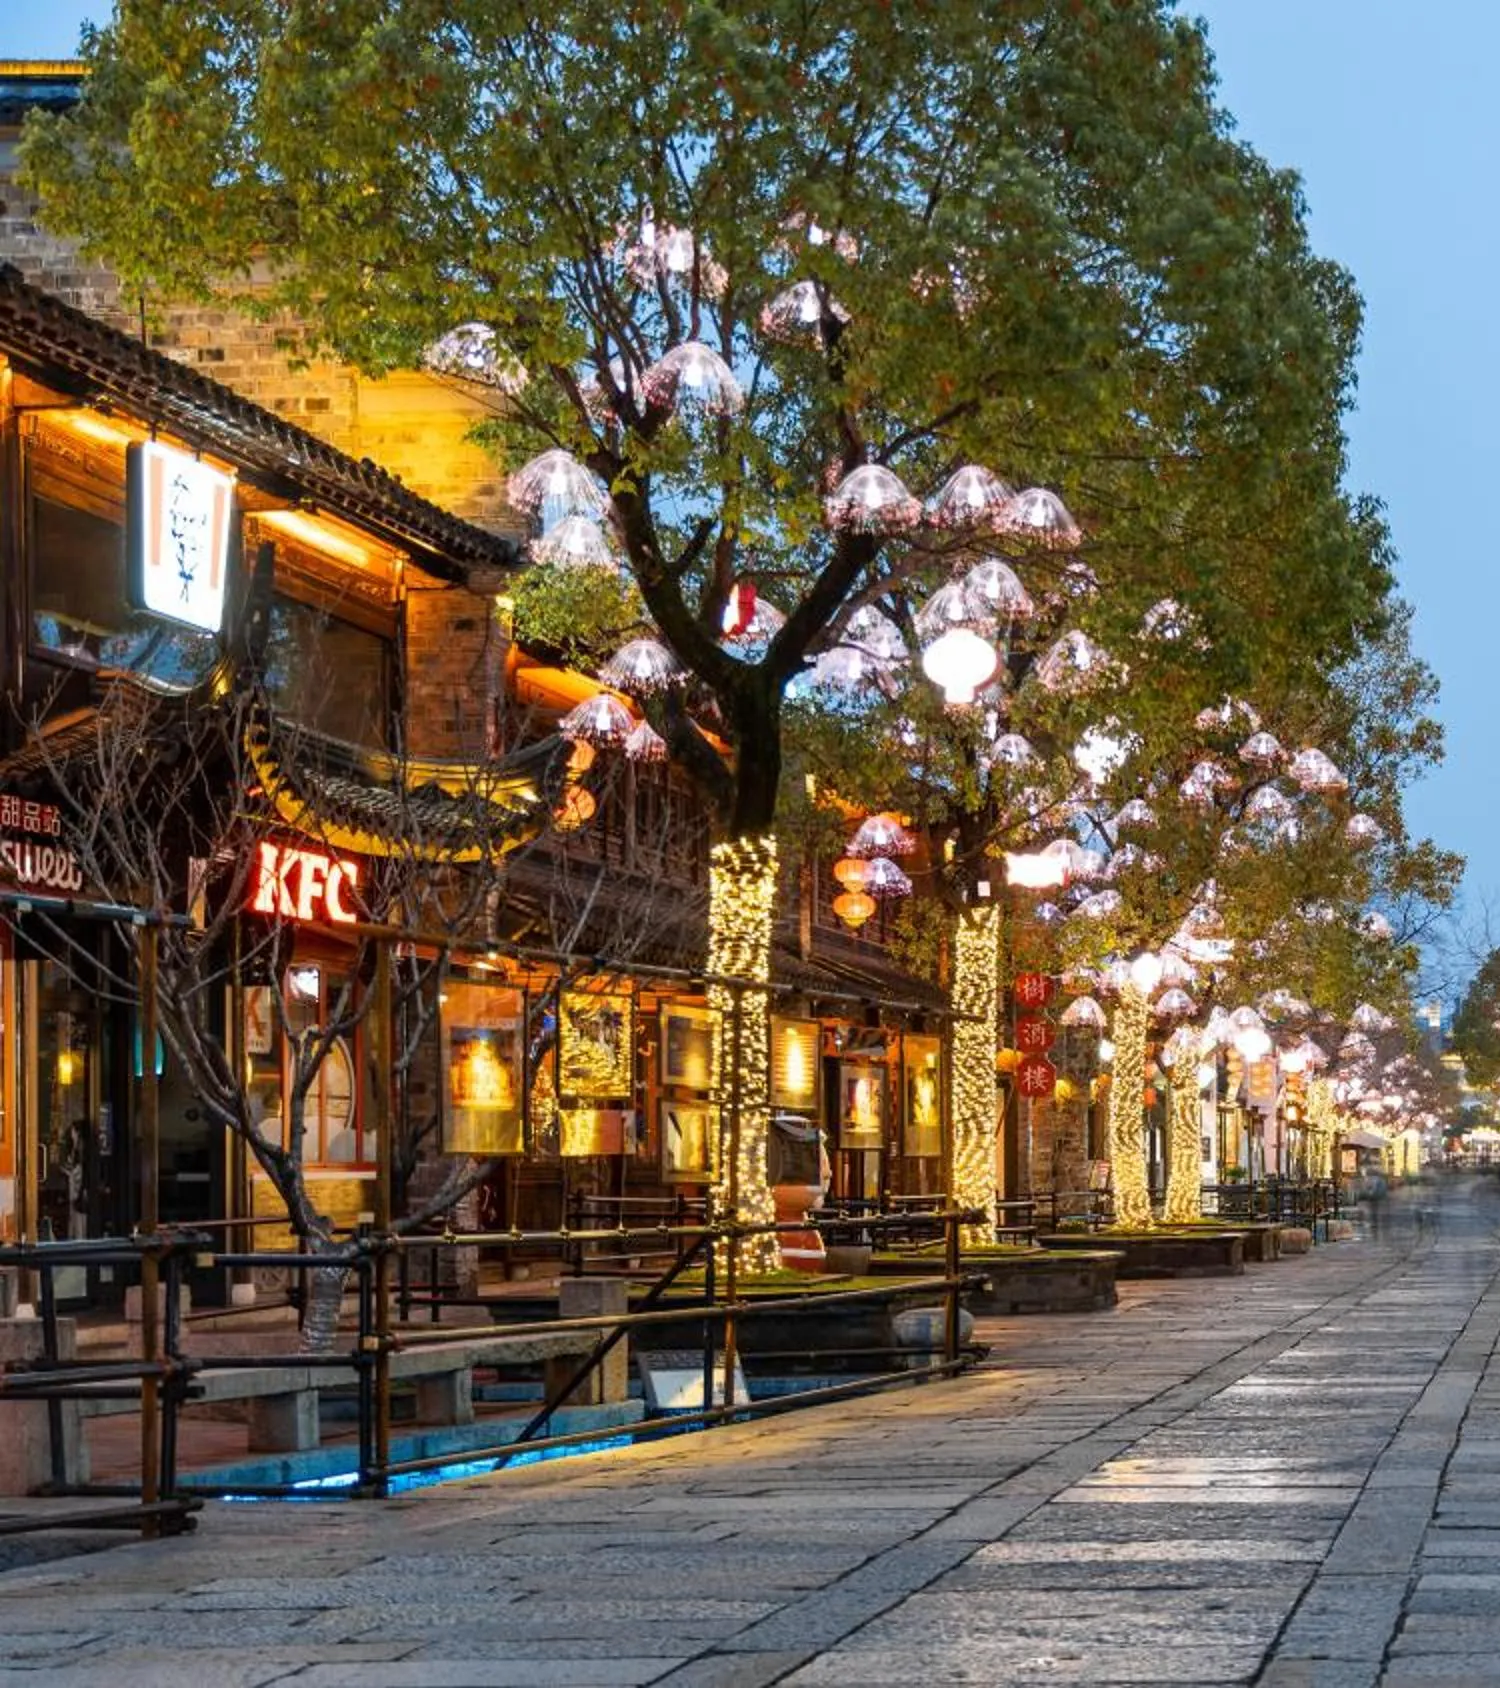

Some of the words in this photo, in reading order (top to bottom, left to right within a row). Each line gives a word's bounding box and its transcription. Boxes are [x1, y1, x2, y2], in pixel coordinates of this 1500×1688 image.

[1, 794, 61, 837] 甜品站
[254, 841, 358, 924] KFC
